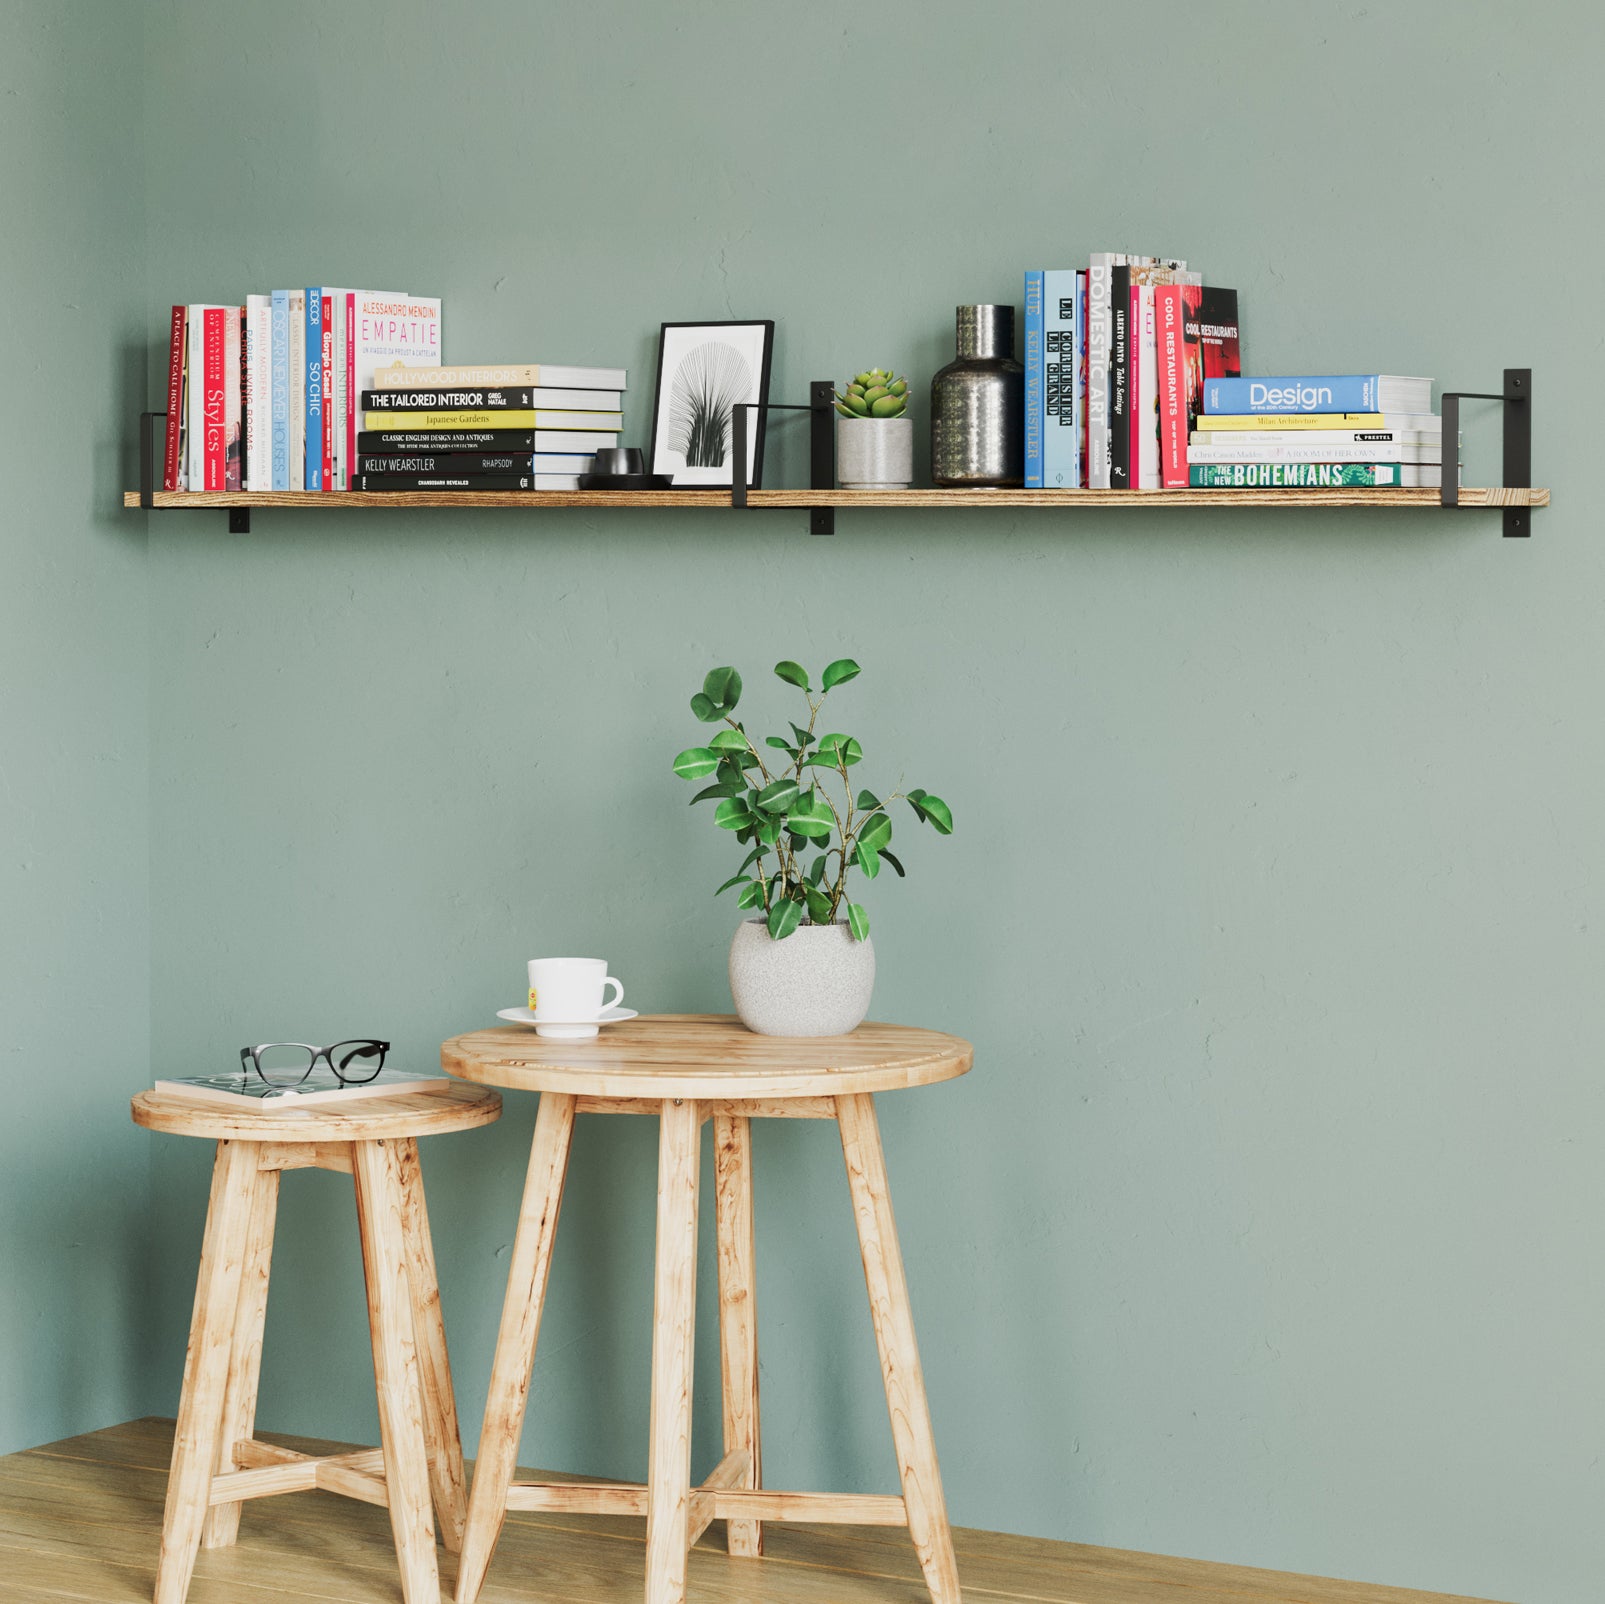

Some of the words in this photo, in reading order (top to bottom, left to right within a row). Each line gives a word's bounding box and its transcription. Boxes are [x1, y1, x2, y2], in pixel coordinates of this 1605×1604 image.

[1027, 279, 1040, 316] HUE
[209, 313, 215, 326] OF
[362, 302, 407, 317] ALESSANDRO
[408, 304, 437, 319] MENDINI
[1060, 299, 1072, 319] LE
[1164, 297, 1174, 329] COOL
[273, 310, 286, 356] OSCAR
[362, 319, 437, 345] EMPATIE
[1090, 265, 1105, 379] DOMESTIC
[1117, 309, 1125, 340] ALBERTO
[1185, 323, 1200, 336] COOL
[1200, 324, 1238, 339] RESTAURANTS
[322, 331, 332, 368] Giorgio
[1028, 330, 1039, 373] KELLY
[1047, 332, 1059, 352] LE
[1117, 341, 1125, 363] PINTO
[173, 350, 179, 363] TO
[309, 361, 321, 382] SO
[384, 370, 457, 385] HOLLYWOOD
[460, 369, 518, 383] INTERIORS
[1060, 331, 1072, 426] CORBUSIER
[1117, 367, 1125, 386] Table
[1166, 331, 1178, 416] RESTAURANTS
[323, 369, 331, 399] Casali
[1047, 363, 1059, 415] GRAND
[309, 383, 321, 416] CHIC
[371, 394, 390, 407] THE
[390, 394, 438, 407] TAILORED
[438, 393, 484, 406] INTERIOR
[487, 392, 502, 400] GREG
[488, 398, 507, 406] NATALE
[1090, 387, 1105, 425] ART
[1114, 387, 1125, 415] Settings
[1249, 383, 1333, 410] Design
[204, 389, 225, 452] Styles
[426, 415, 459, 425] Japanese
[459, 414, 490, 424] Gardens
[1028, 378, 1039, 459] WEARSTLER
[1257, 417, 1276, 425] Milan
[1278, 416, 1319, 425] Architecture
[273, 421, 285, 472] HOUSES
[382, 434, 405, 442] CLASSIC
[405, 434, 430, 442] ENGLISH
[466, 433, 494, 442] ANTIQUES
[1293, 448, 1321, 457] ROOM
[1334, 448, 1353, 457] HER
[1354, 447, 1376, 457] OWN
[365, 459, 387, 471] KELLY
[388, 458, 435, 471] WEARSTLER
[482, 459, 513, 468] RHAPSODY
[1217, 465, 1232, 475] THE
[1214, 476, 1231, 486] NEW
[1234, 464, 1343, 486] BOHEMIANS
